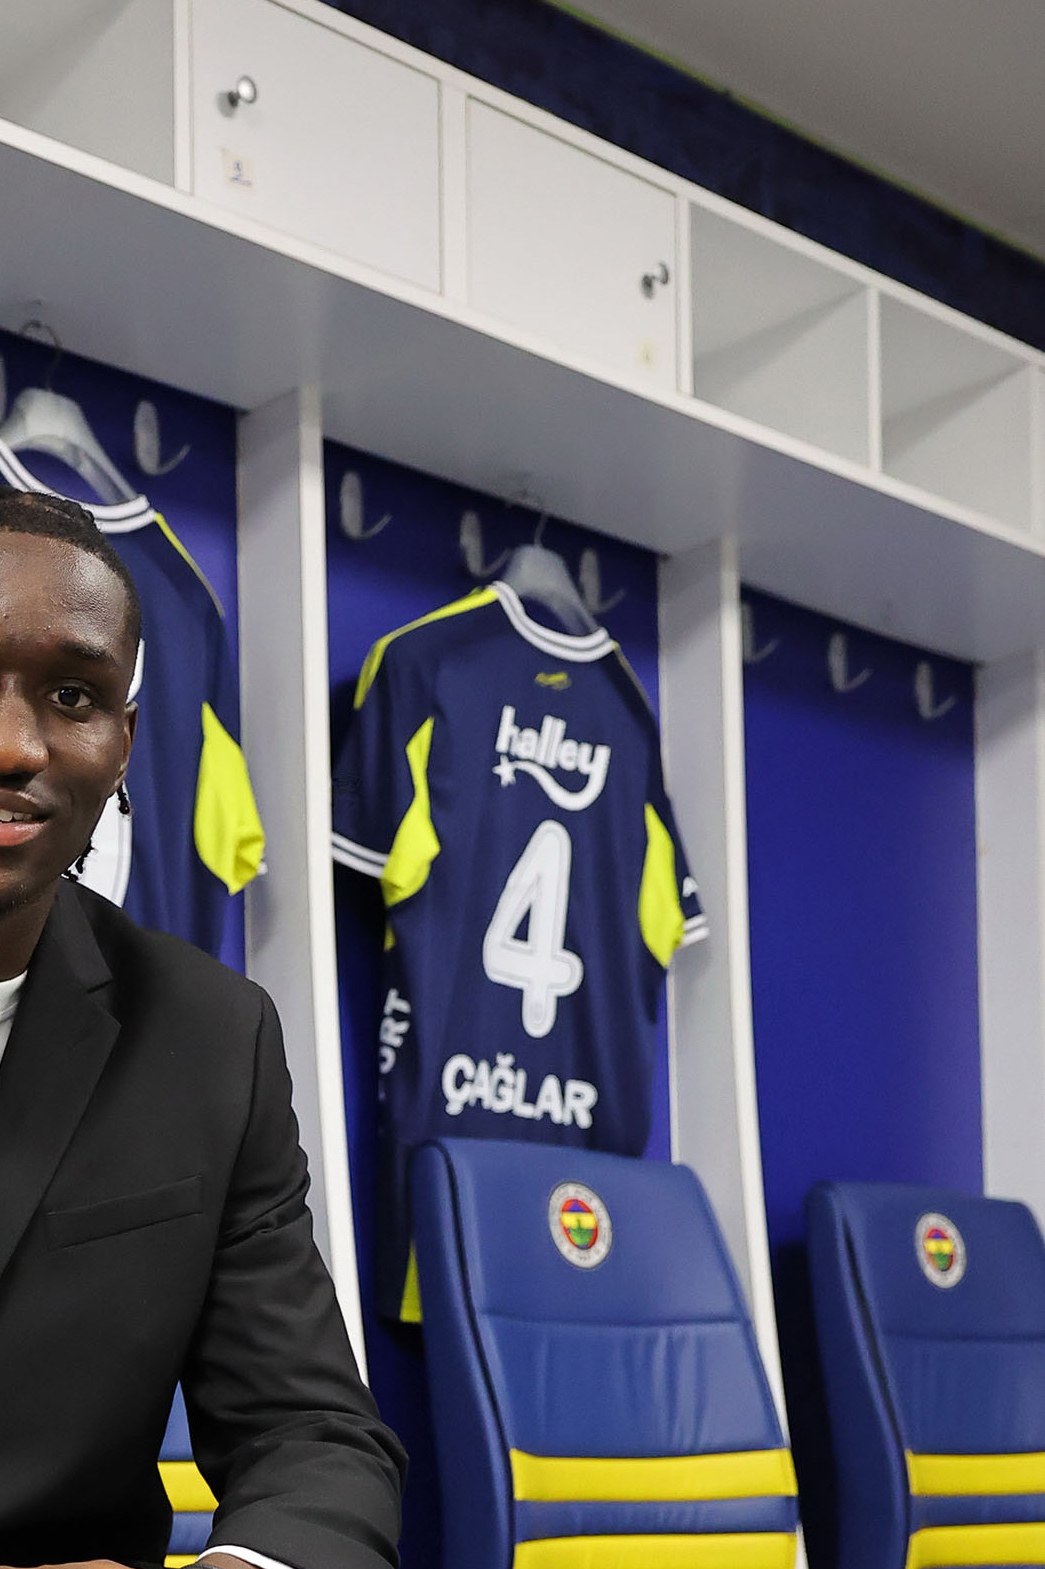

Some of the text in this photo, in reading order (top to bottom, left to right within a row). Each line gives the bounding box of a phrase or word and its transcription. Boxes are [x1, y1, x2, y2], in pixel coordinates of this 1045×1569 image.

[495, 704, 612, 811] halley
[482, 819, 584, 1038] 4
[441, 1051, 599, 1130] ÇAĞLAR
